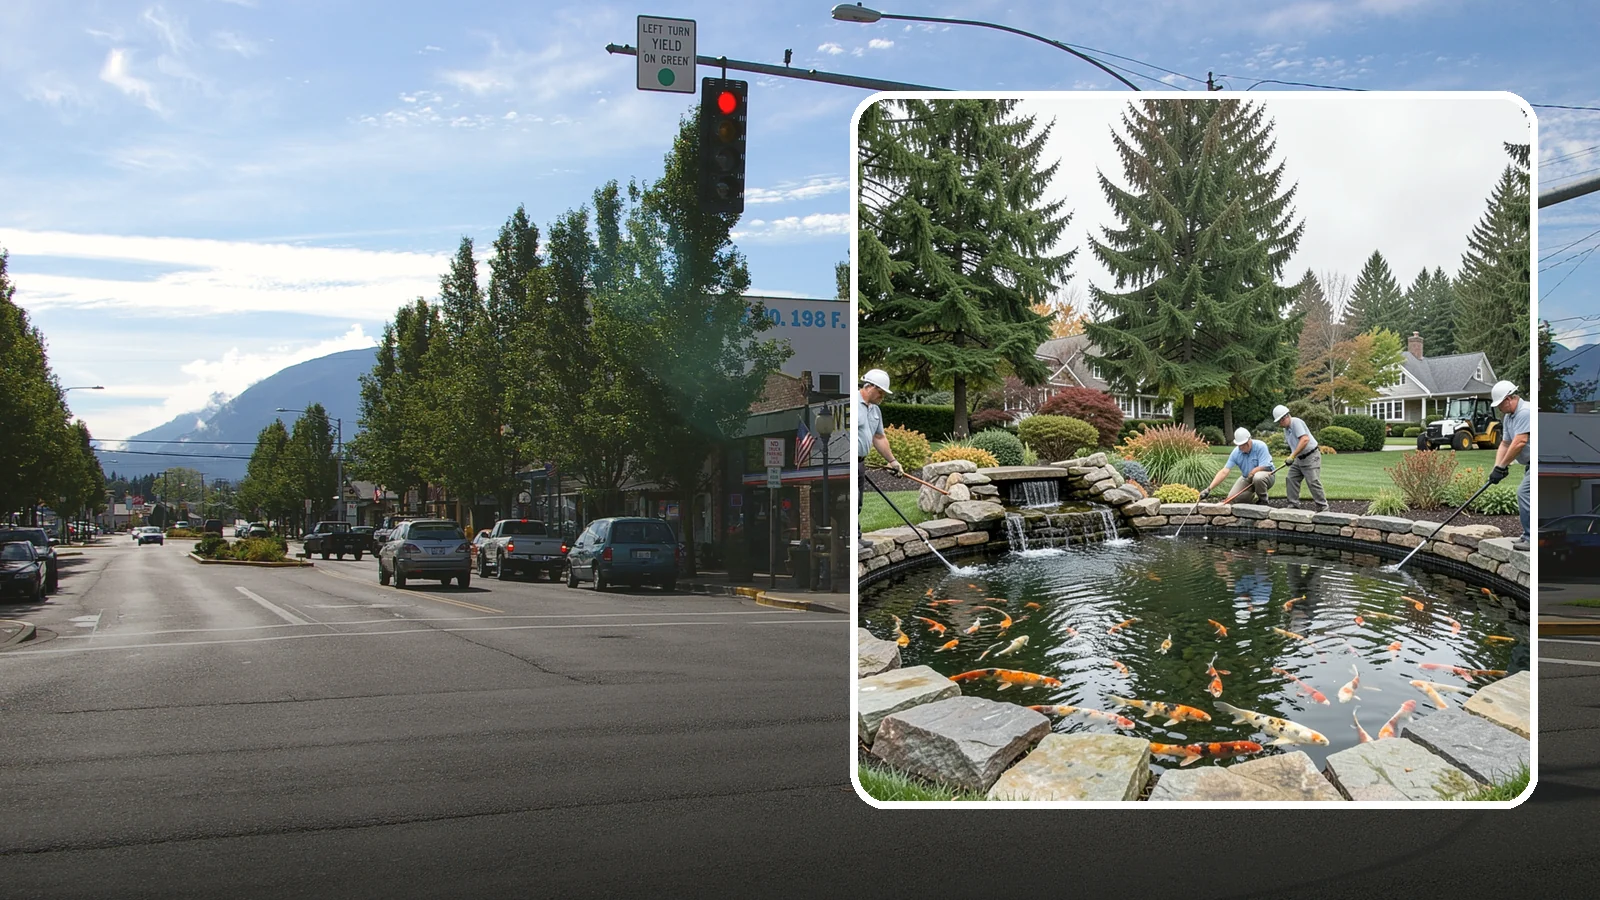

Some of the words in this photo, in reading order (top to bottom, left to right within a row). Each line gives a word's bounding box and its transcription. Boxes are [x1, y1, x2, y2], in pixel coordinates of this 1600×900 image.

[643, 24, 663, 34] LEFT
[668, 26, 690, 36] TURN
[652, 38, 682, 51] YIELD
[644, 54, 656, 63] ON
[661, 55, 688, 66] GREEN
[791, 309, 826, 328] 198
[831, 311, 847, 329] F.
